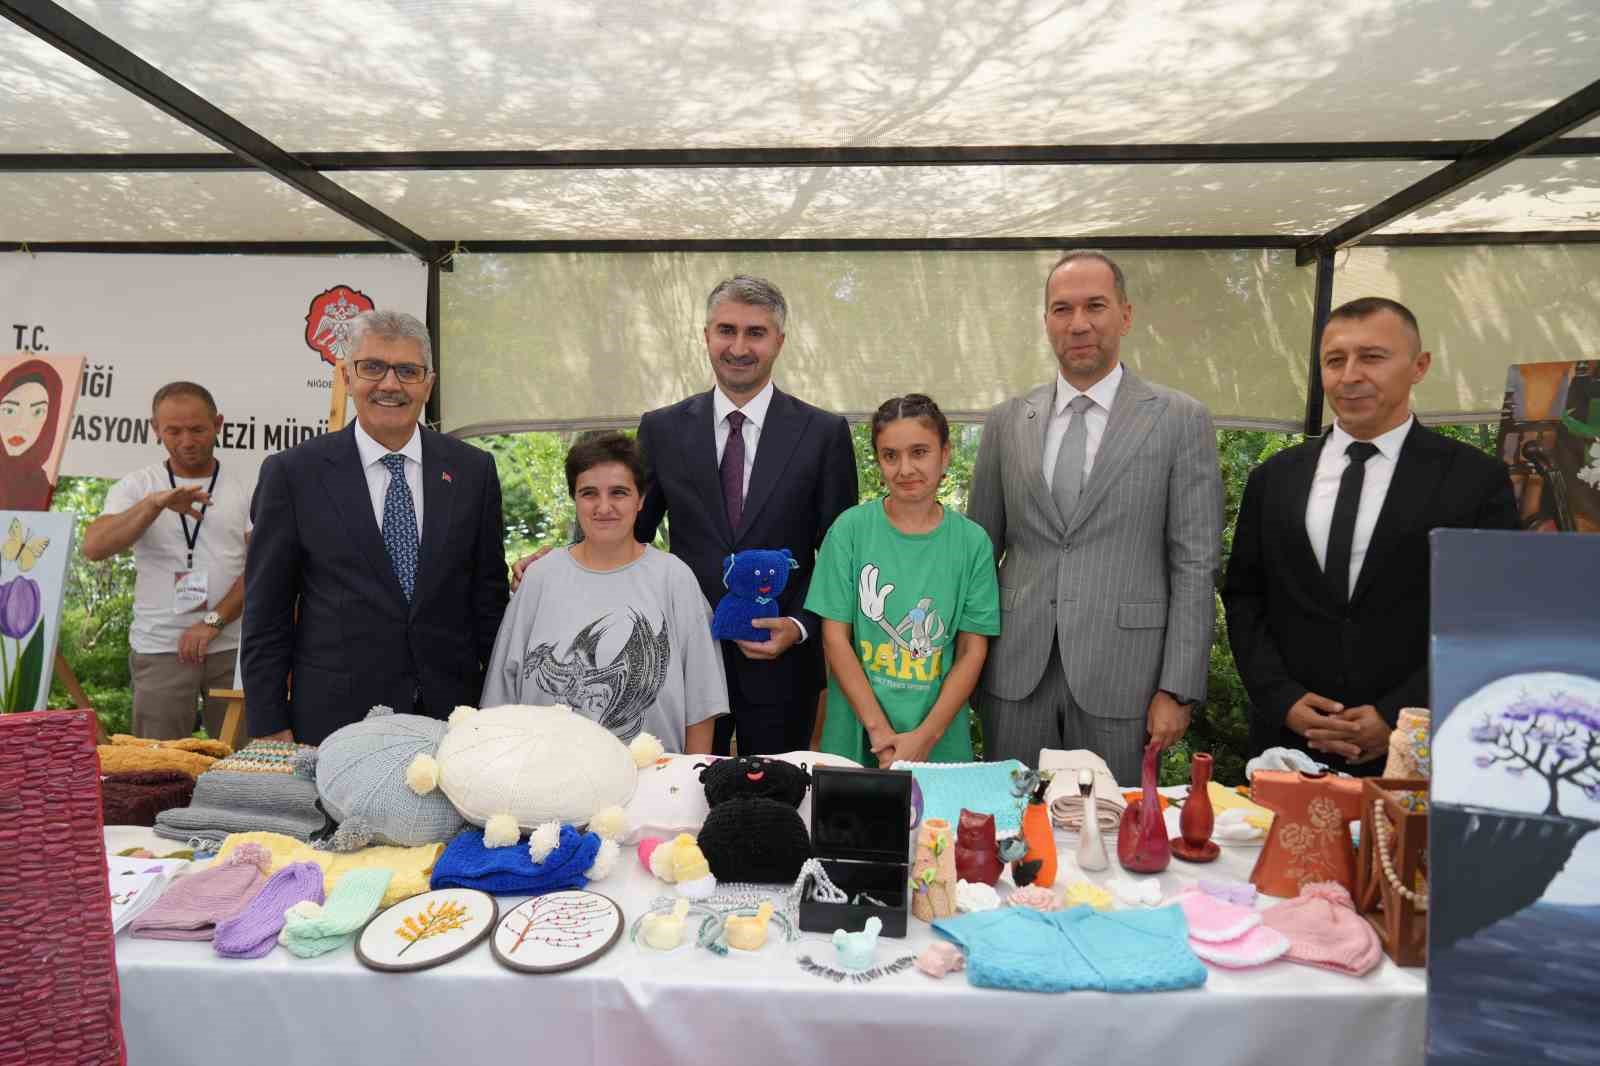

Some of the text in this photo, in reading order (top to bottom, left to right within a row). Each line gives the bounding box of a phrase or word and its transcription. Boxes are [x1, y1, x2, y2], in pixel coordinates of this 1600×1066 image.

[13, 324, 49, 351] T.C.
[81, 364, 114, 398] İĞİ
[71, 415, 150, 444] ASYON
